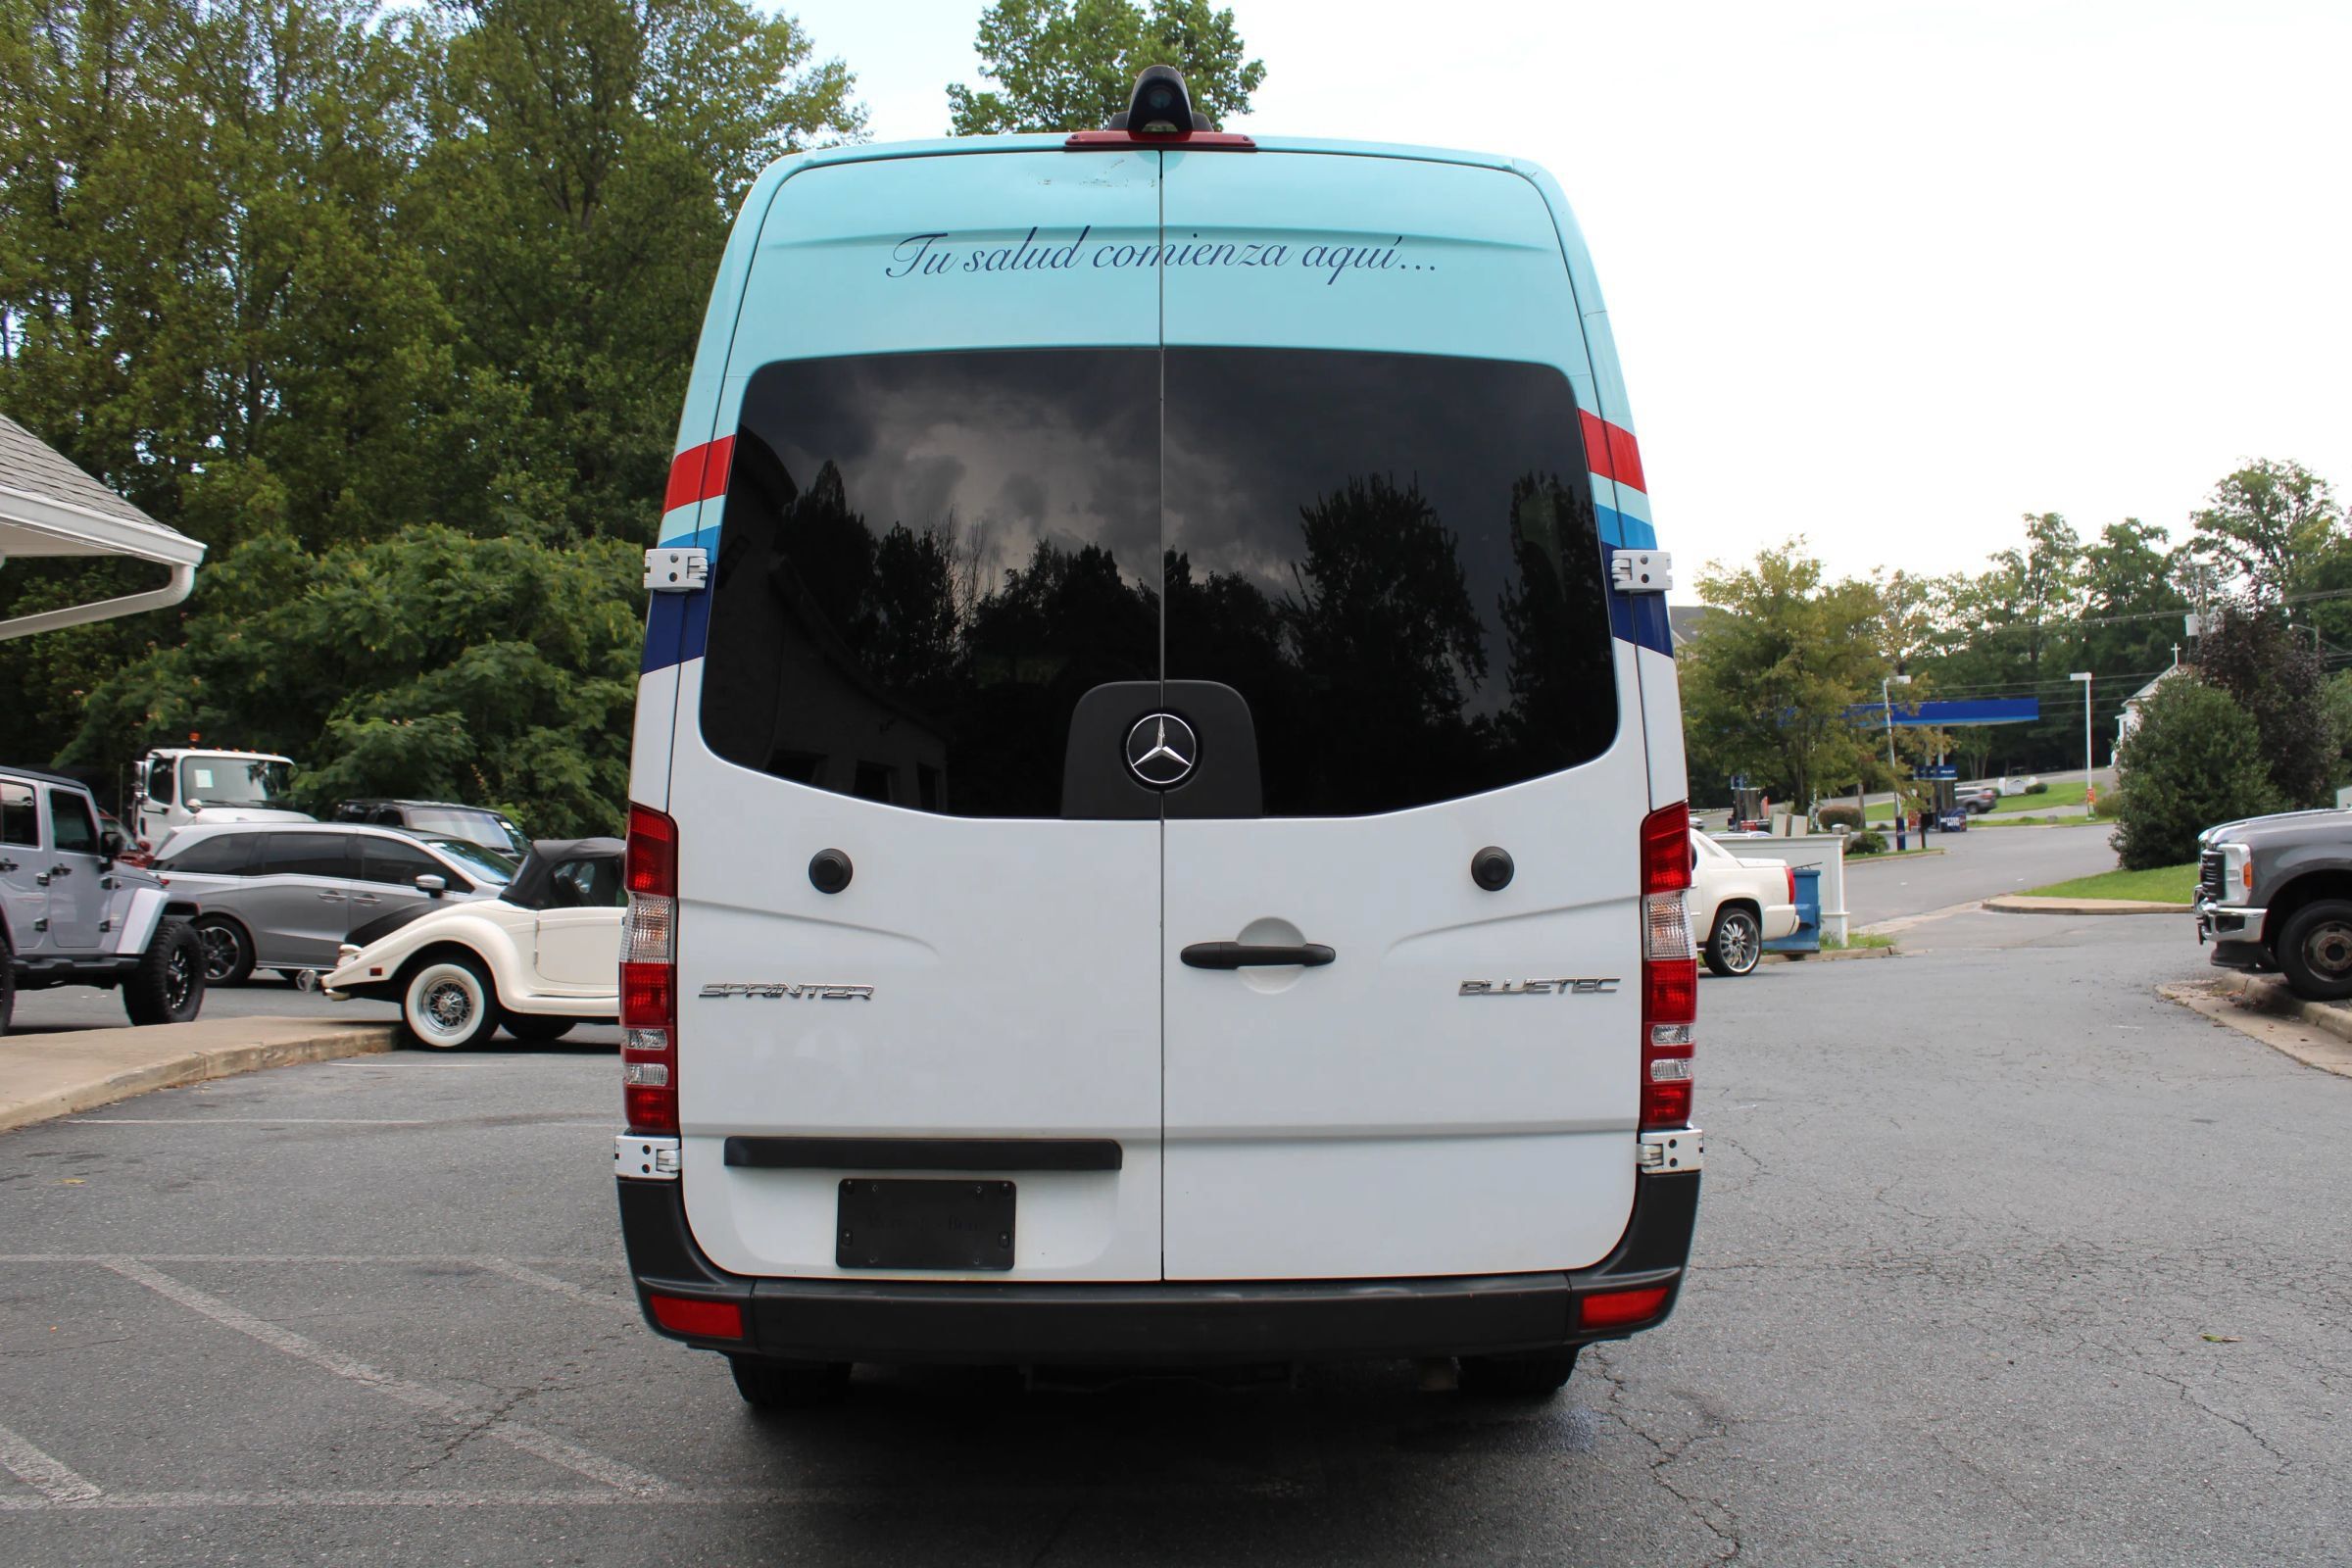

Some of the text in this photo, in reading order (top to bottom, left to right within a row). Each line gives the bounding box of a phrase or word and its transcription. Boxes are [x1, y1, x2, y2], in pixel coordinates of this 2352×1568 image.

[885, 224, 1436, 286] Tu salud comienza aquí...
[698, 981, 874, 1001] SPRINTER
[1458, 978, 1621, 997] BLUETEC
